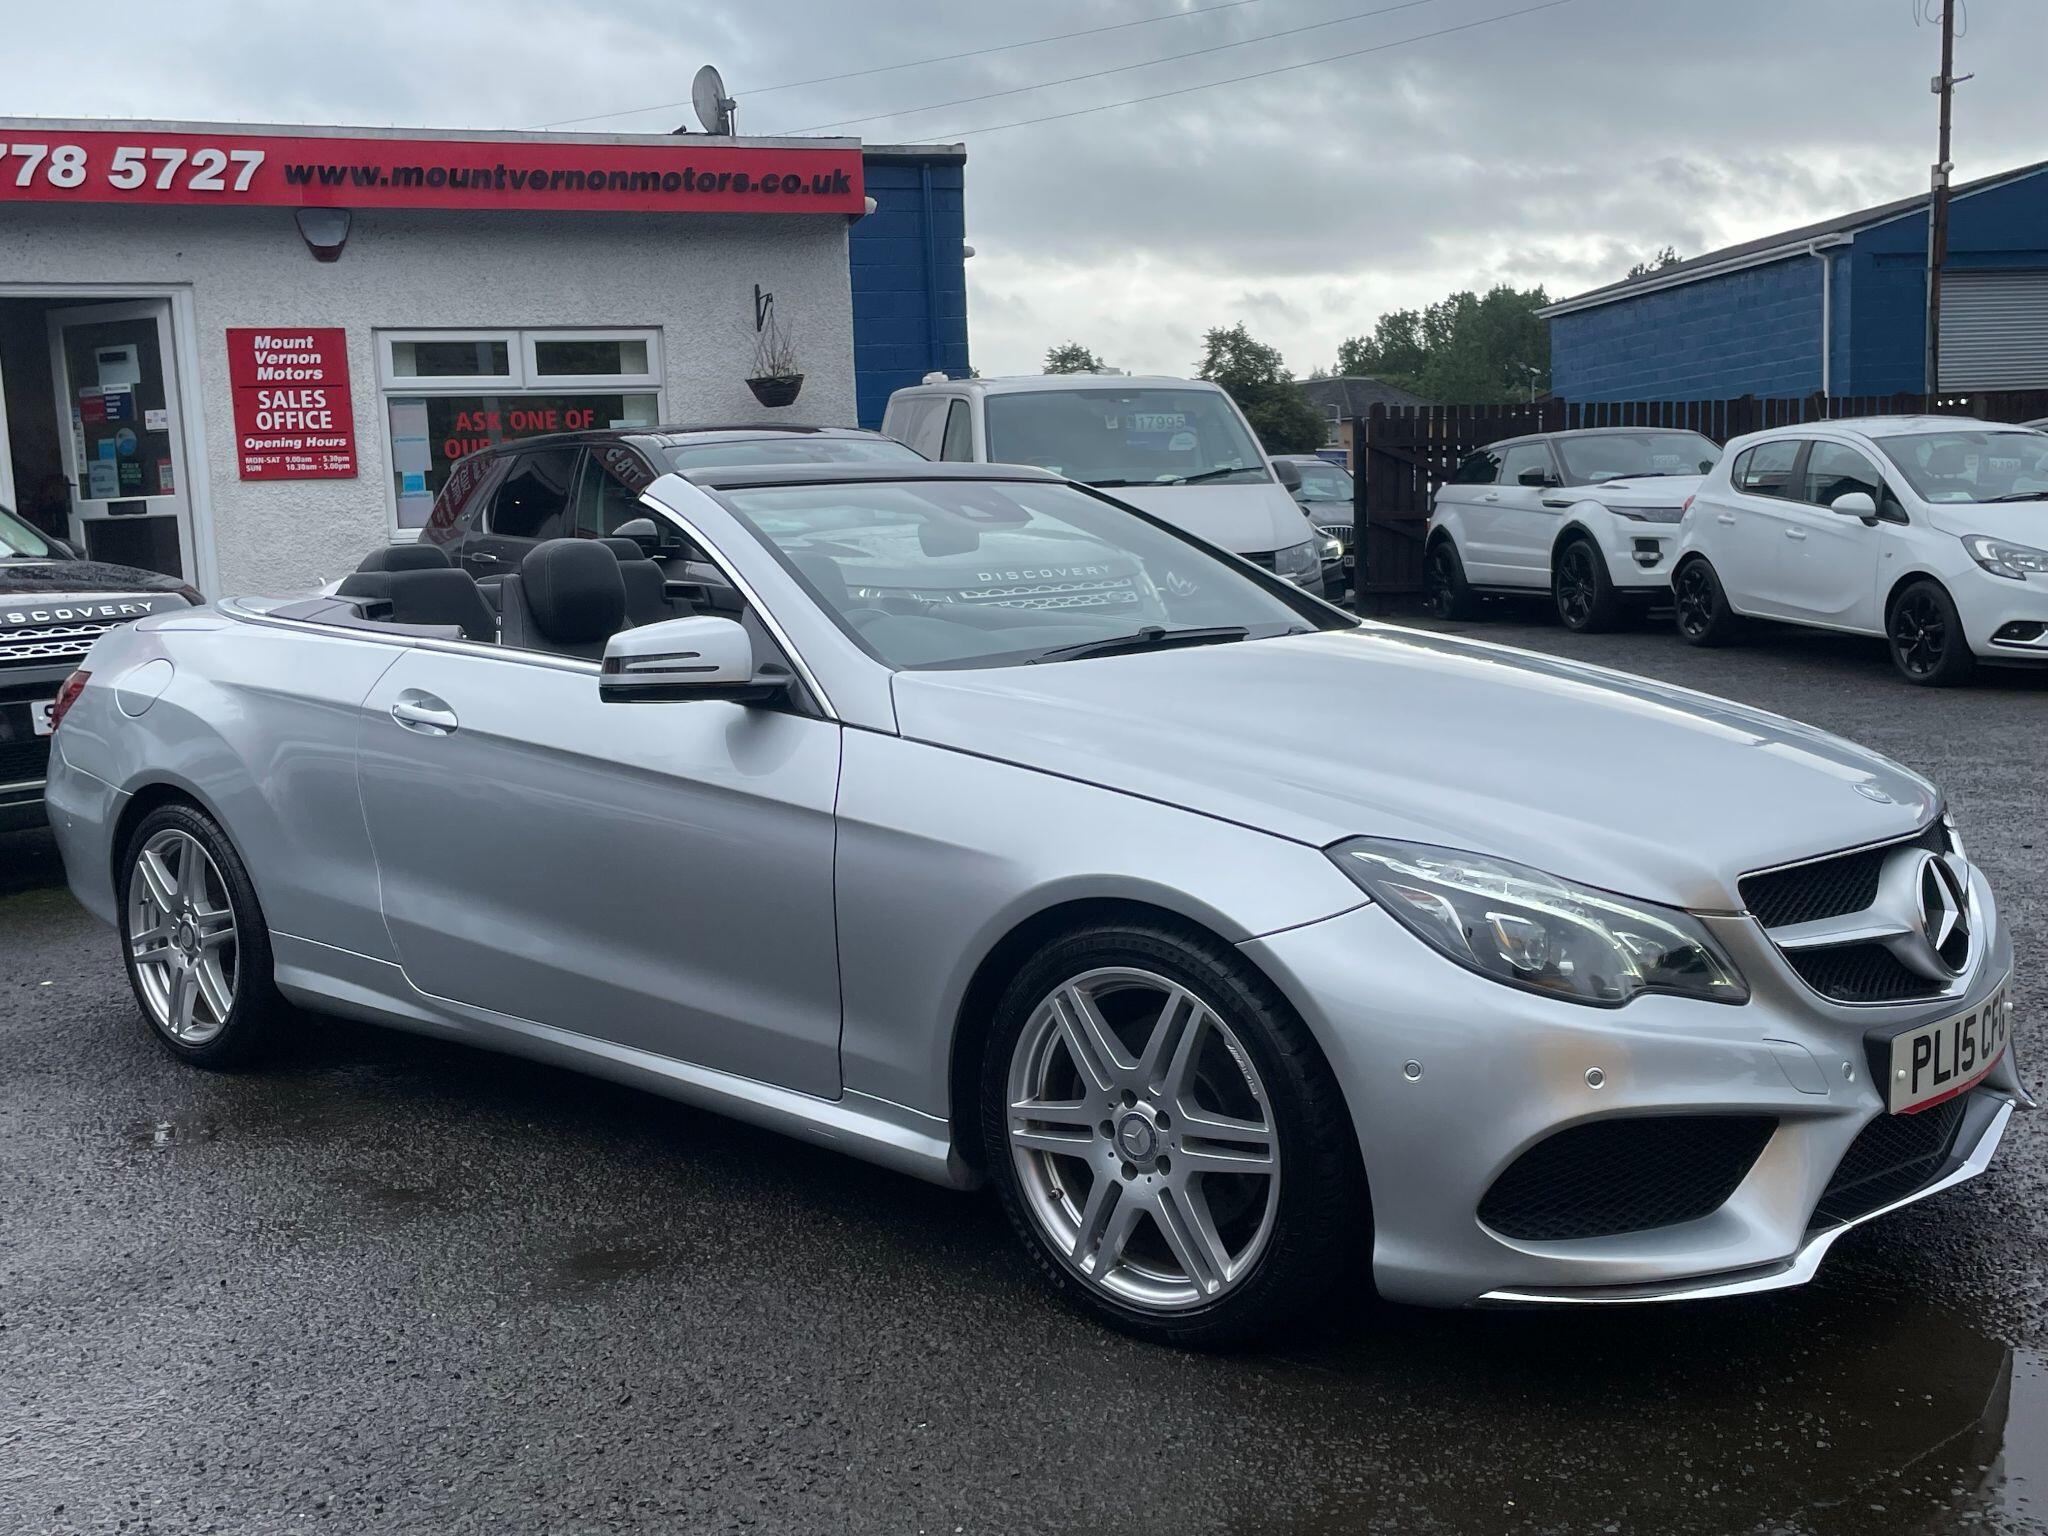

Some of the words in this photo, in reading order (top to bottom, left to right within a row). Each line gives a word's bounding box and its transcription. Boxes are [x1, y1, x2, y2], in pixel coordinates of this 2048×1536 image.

[0, 143, 88, 188] 78
[107, 146, 265, 192] 5727
[284, 163, 851, 194] www.mountvernonmotors.co.uk
[254, 335, 314, 350] Mount
[254, 351, 322, 365] Vernon
[257, 367, 324, 381] Motors
[257, 390, 327, 409] SALES
[256, 410, 333, 430] OFFICE
[456, 411, 502, 431] ASK
[509, 410, 558, 431] ONE
[565, 409, 595, 430] OF
[244, 437, 302, 450] Opening
[306, 436, 347, 447] Hours
[245, 456, 280, 464] MON-SAT
[977, 564, 1111, 582] DISCOVERY
[0, 602, 152, 625] SCOVERY
[1911, 1013, 1977, 1095] PL15
